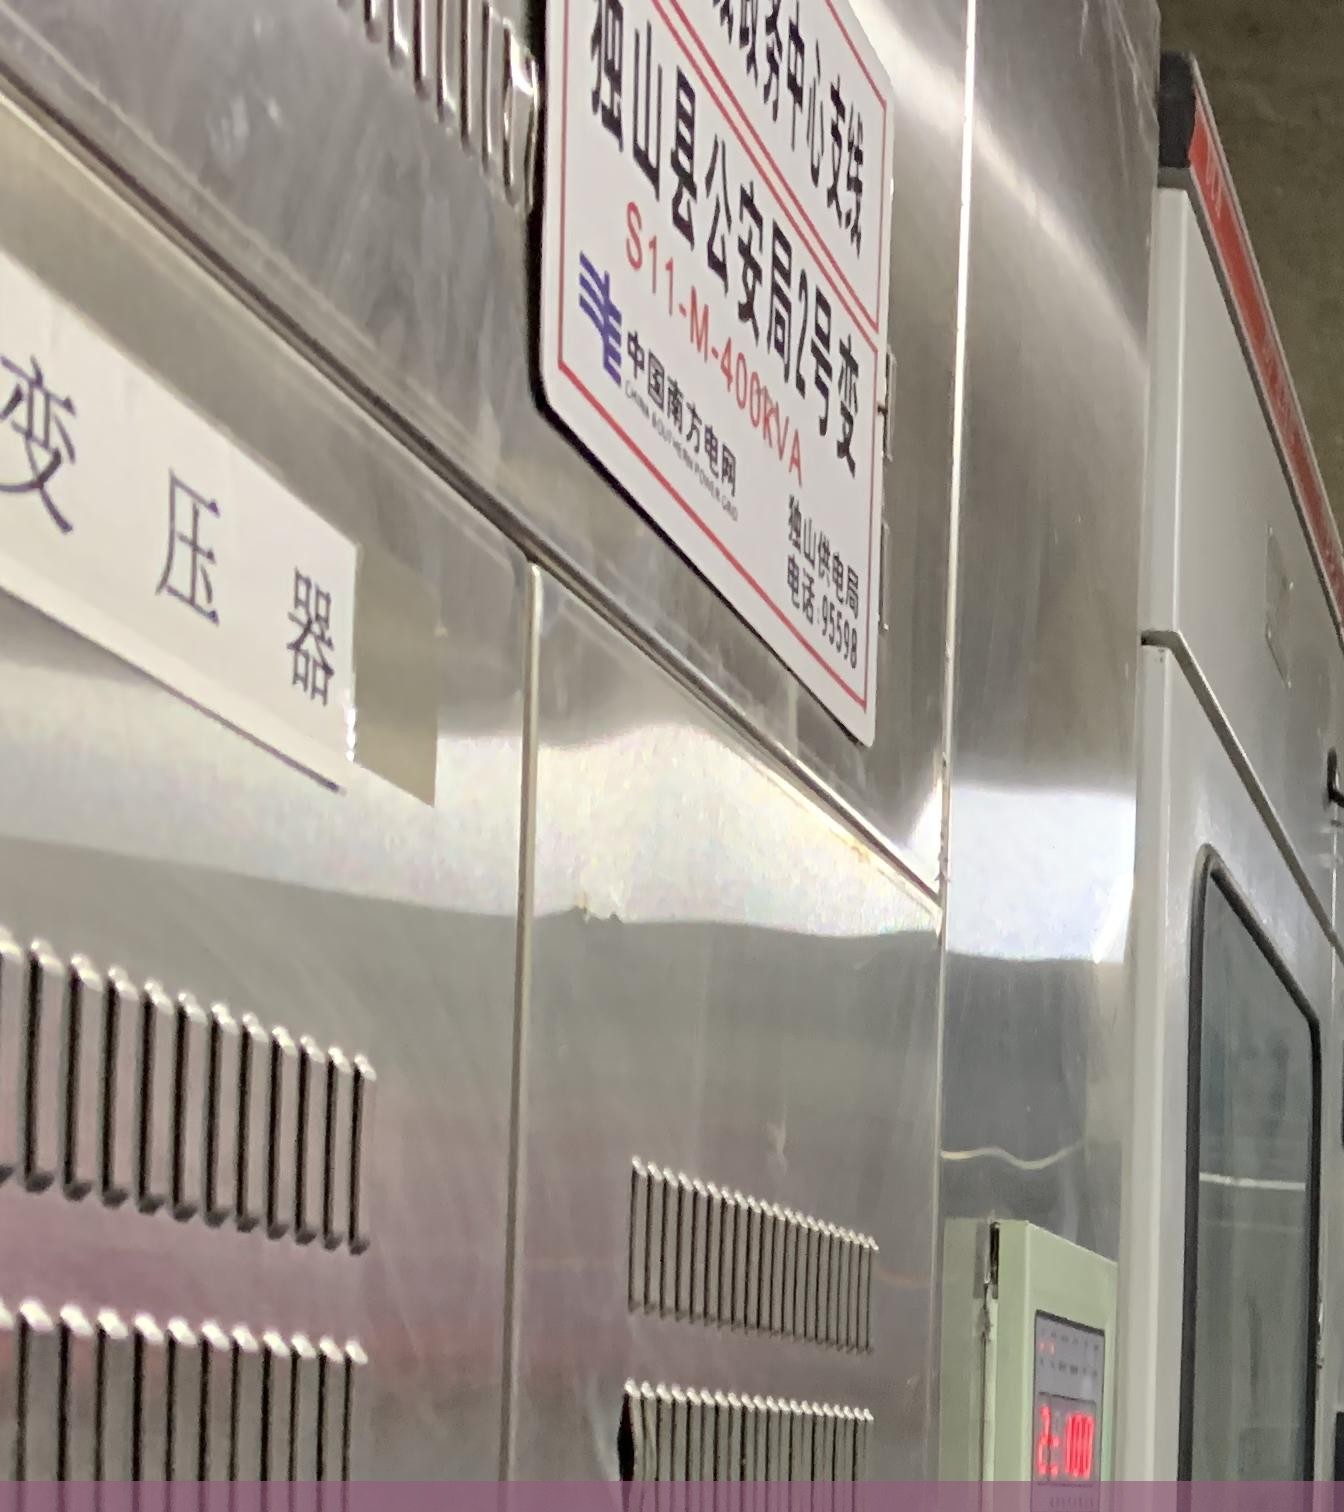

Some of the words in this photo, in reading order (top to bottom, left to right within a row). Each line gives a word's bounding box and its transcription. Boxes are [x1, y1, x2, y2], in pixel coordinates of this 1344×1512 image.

[627, 330, 736, 497] 中国南方电网
[0, 354, 336, 707] 变压器
[788, 494, 859, 619] 独山供电局
